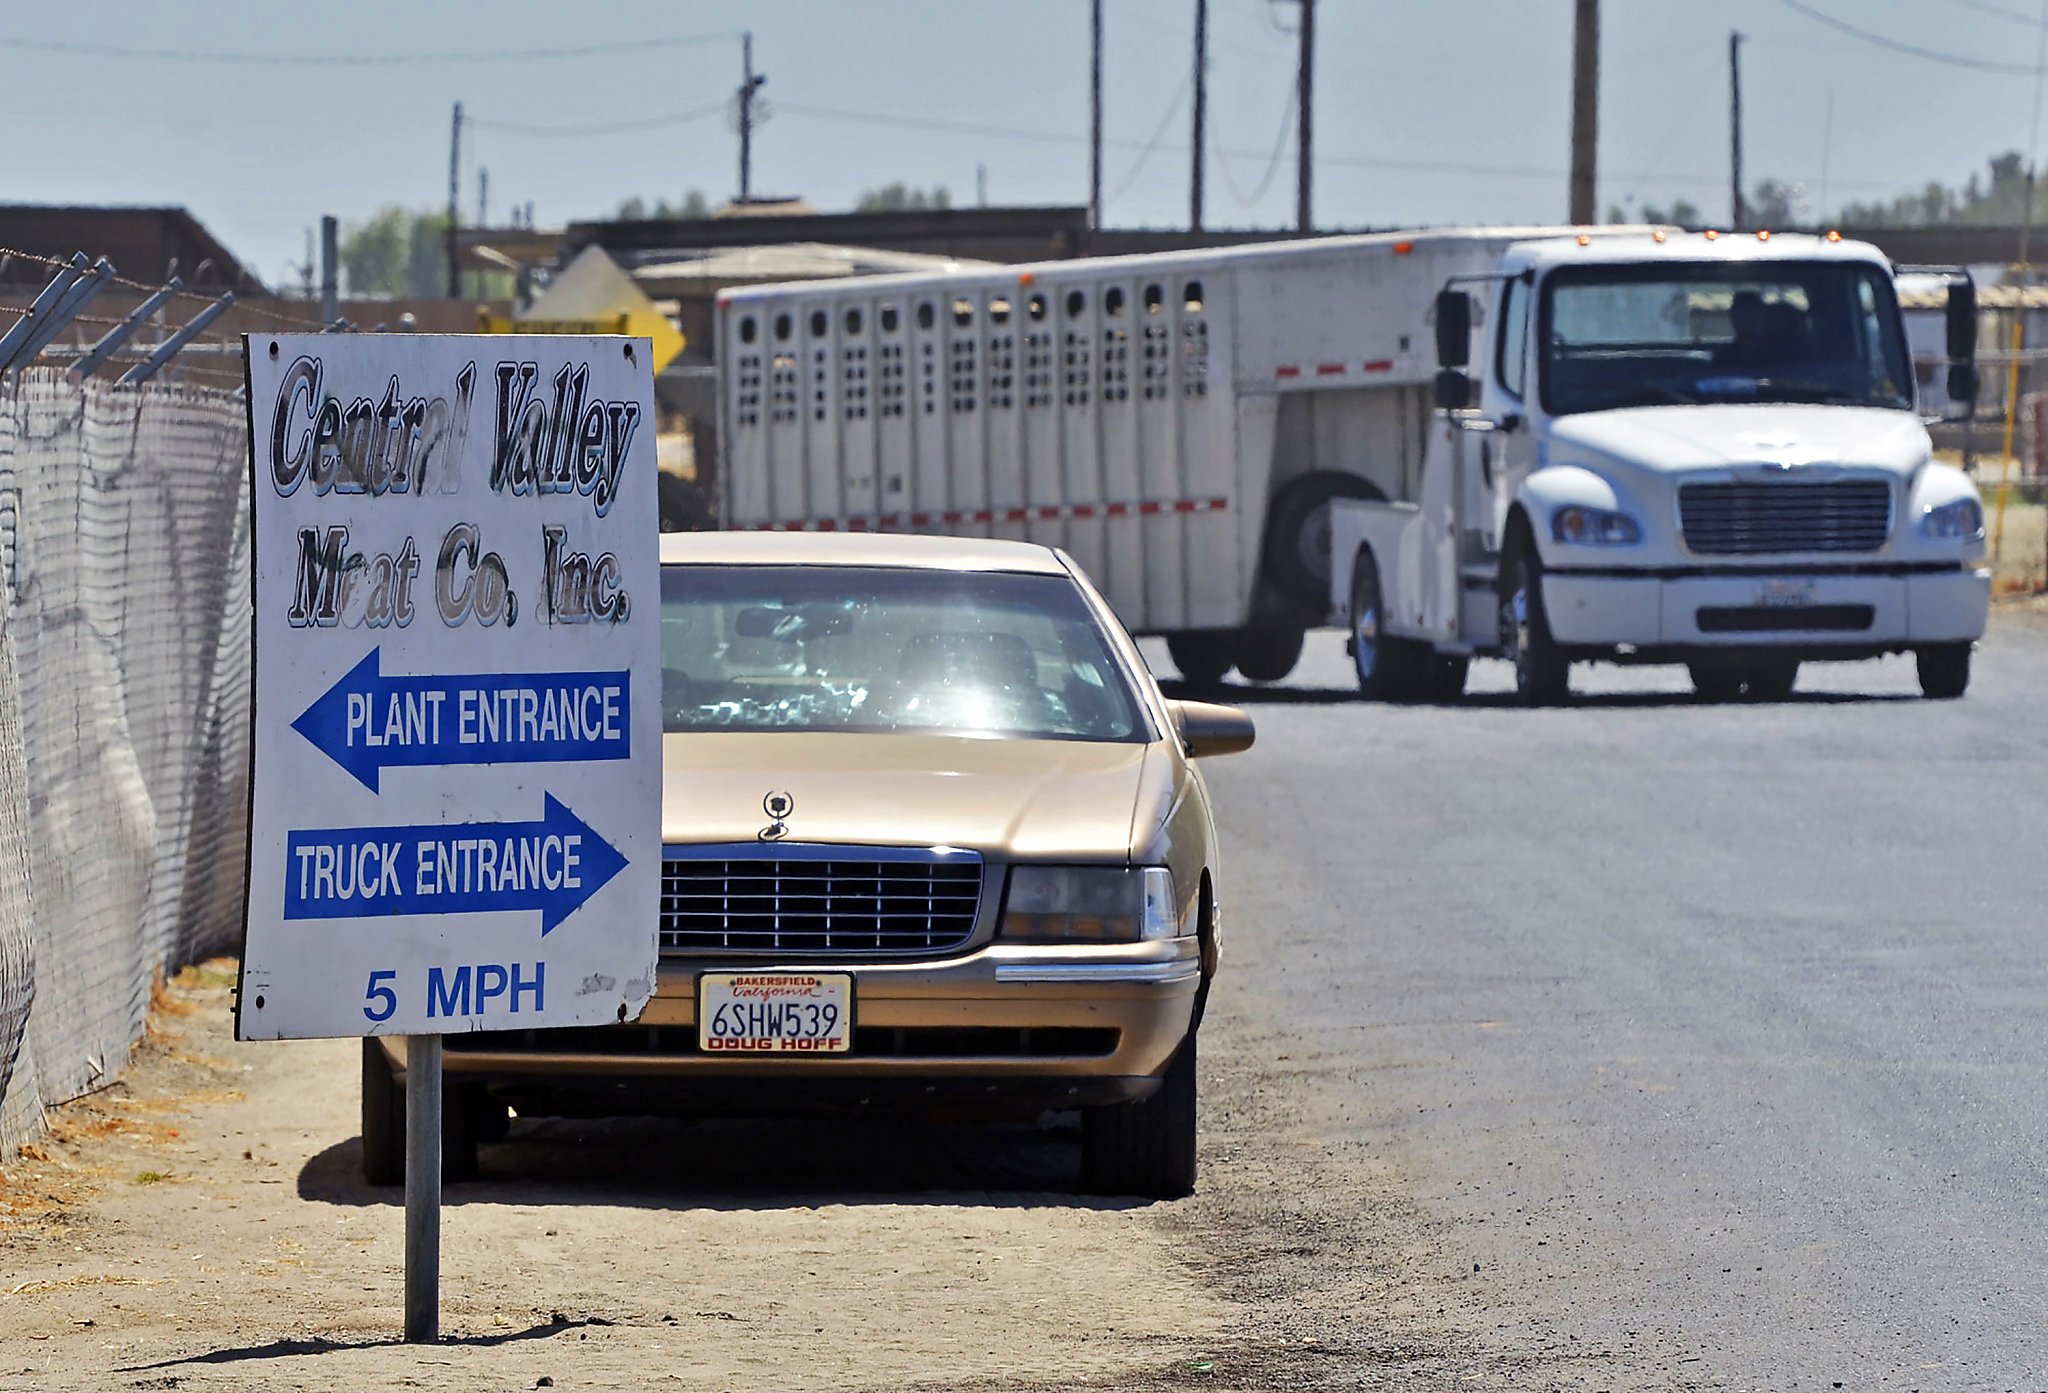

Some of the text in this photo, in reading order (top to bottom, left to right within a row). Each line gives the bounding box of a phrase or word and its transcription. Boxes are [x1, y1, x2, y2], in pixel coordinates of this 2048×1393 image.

[270, 355, 640, 518] Central Valley
[287, 522, 632, 630] Meat Co. Inc.
[346, 685, 622, 747] PLANT ENTRANCE
[295, 835, 582, 900] TRUCK ENTRANCE
[362, 961, 545, 1022] 5 MPH
[733, 986, 821, 1002] California
[736, 977, 816, 987] BAKERSFIELD
[708, 1038, 842, 1050] DOUG HOFF
[712, 1003, 838, 1037] 6SHW539
